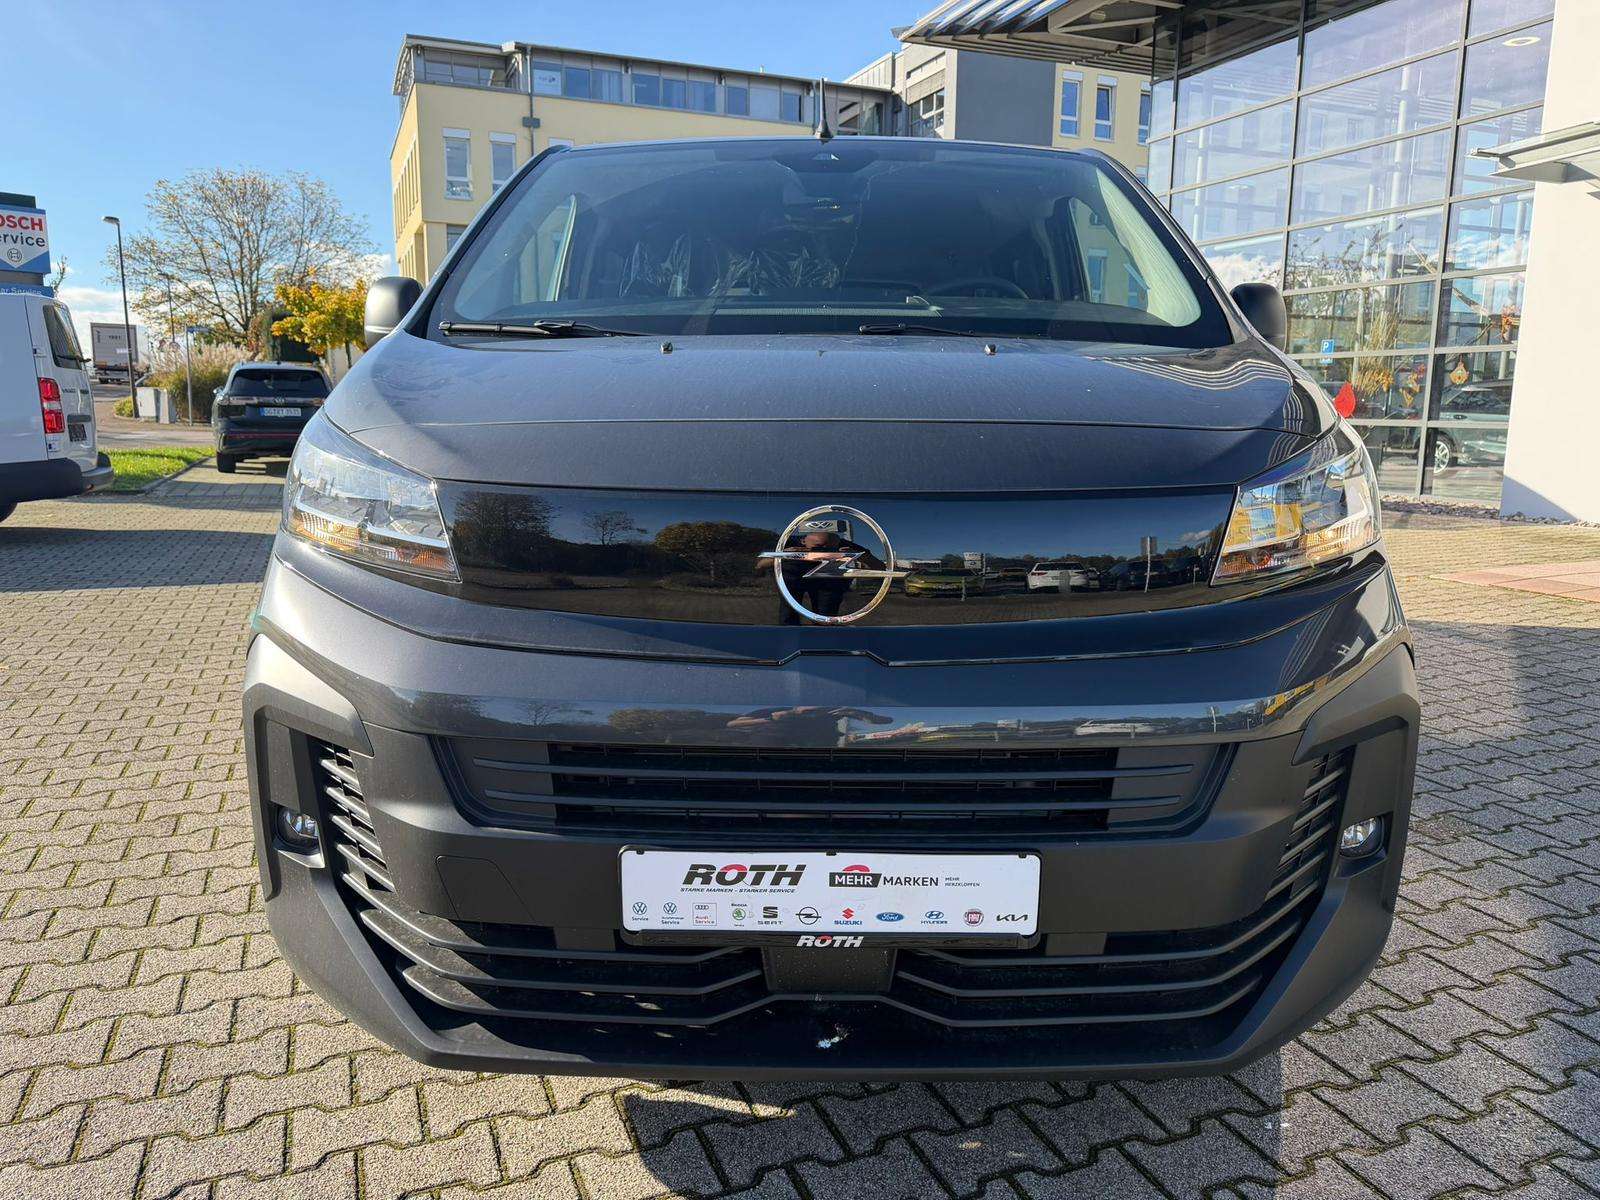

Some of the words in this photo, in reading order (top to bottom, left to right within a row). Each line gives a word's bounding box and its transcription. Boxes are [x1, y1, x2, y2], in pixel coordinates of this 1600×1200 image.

[0, 232, 45, 247] rvice
[682, 864, 807, 886] ROTH
[834, 875, 873, 885] MEHR
[883, 876, 939, 887] MARKEN
[797, 935, 864, 947] ROTH
